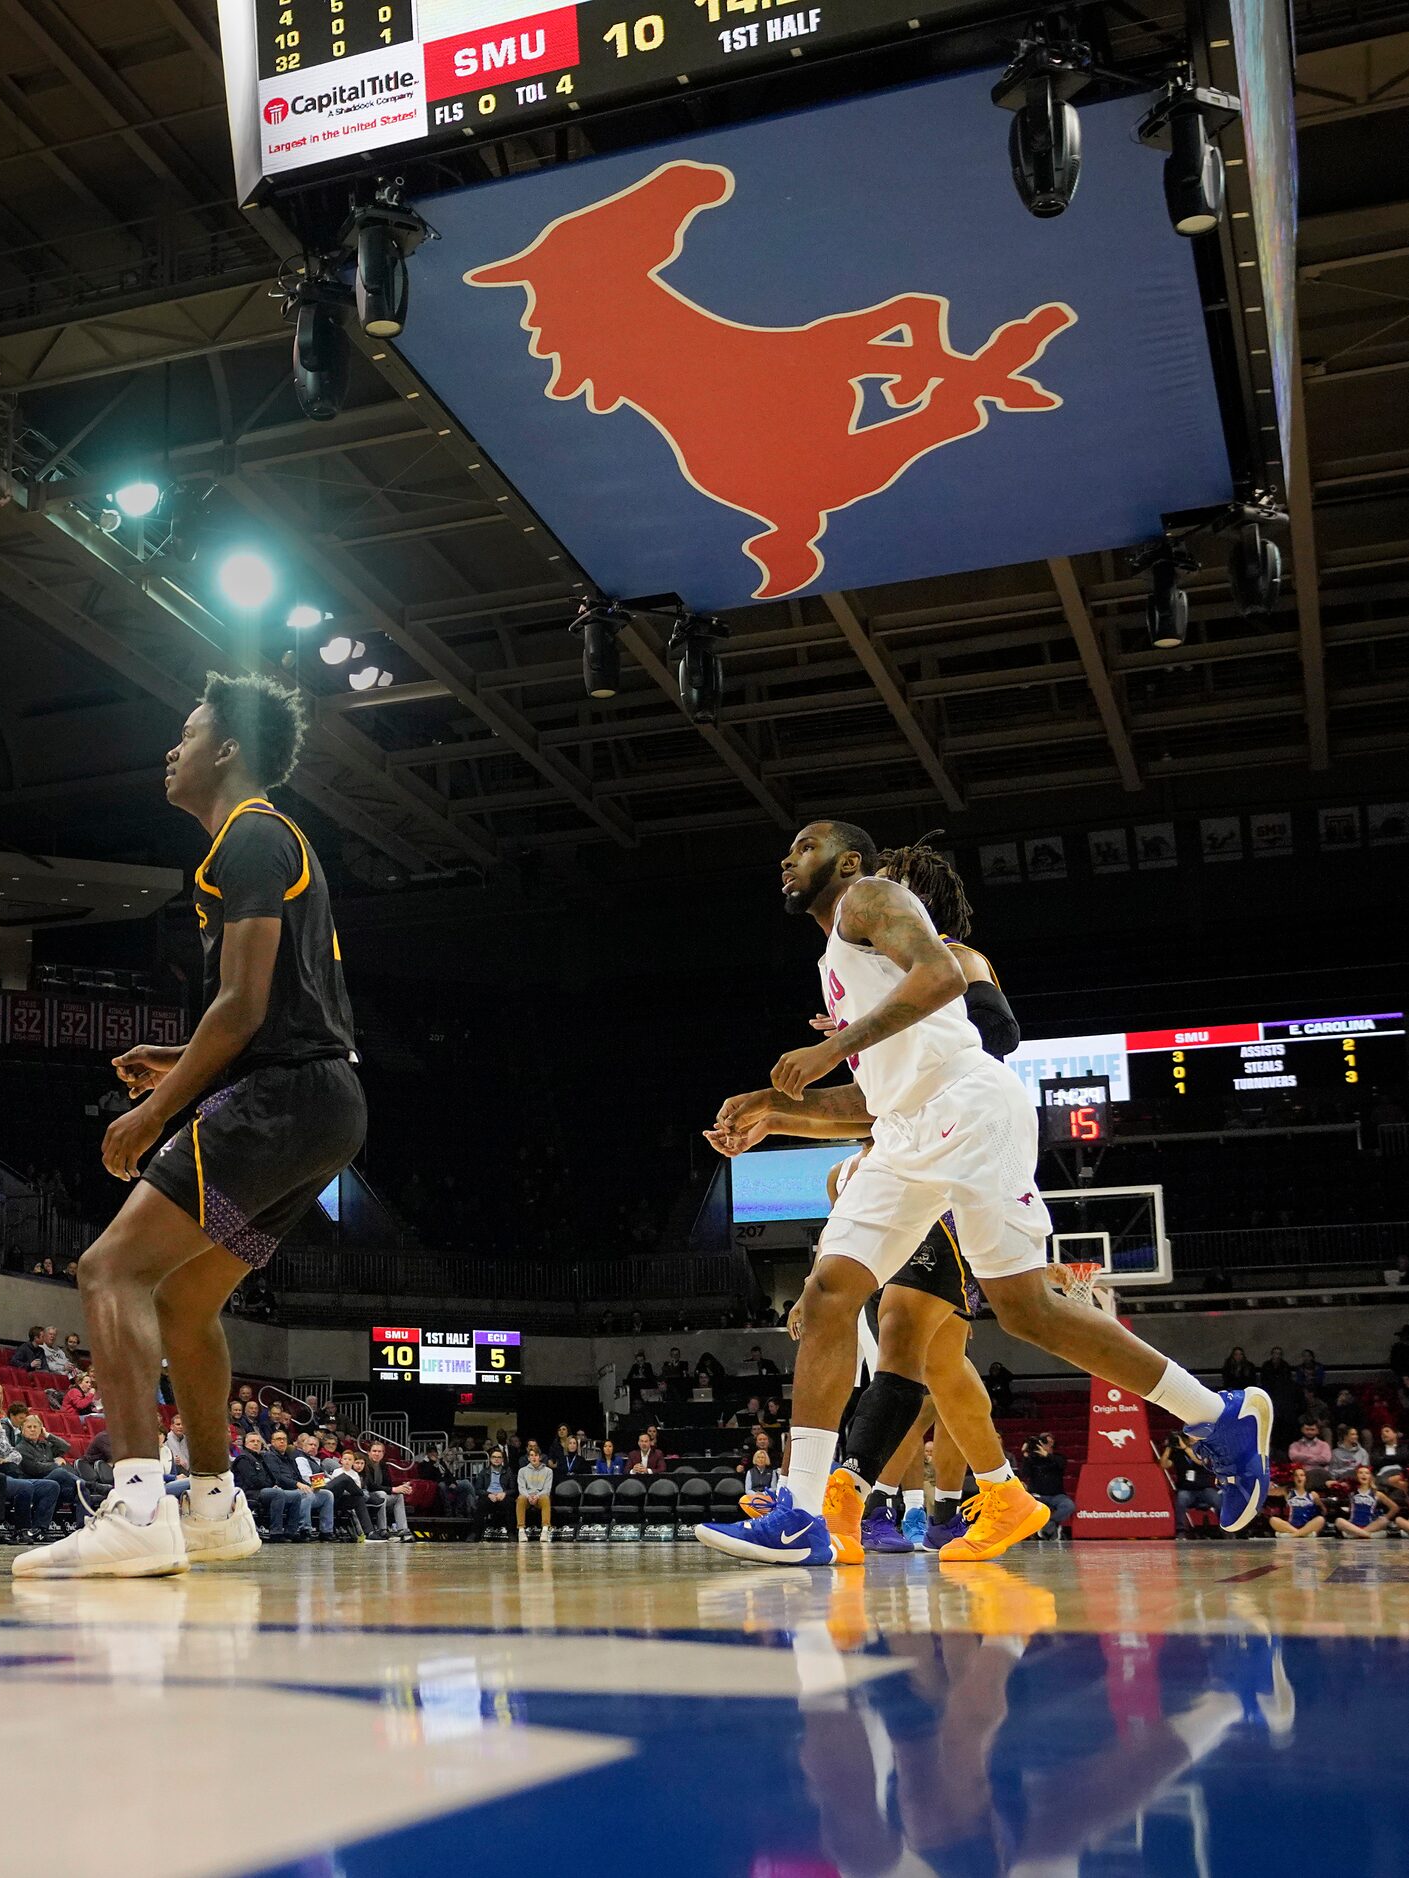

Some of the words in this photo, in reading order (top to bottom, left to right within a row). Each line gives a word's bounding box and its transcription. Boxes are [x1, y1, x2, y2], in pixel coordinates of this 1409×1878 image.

[274, 30, 300, 50] 10
[332, 18, 344, 35] 0
[378, 6, 392, 23] 0
[279, 9, 293, 26] 4
[602, 14, 664, 58] 10
[718, 23, 759, 53] 1ST
[766, 8, 821, 43] HALF
[276, 53, 300, 72] 32
[333, 40, 346, 57] 0
[380, 28, 392, 44] 1
[454, 29, 546, 78] SMU
[376, 91, 414, 107] Company
[435, 102, 464, 125] FLS
[478, 94, 496, 115] 0
[516, 82, 547, 105] TOL
[556, 74, 574, 95] 4
[268, 138, 307, 154] Largest
[310, 134, 320, 143] in
[322, 129, 340, 141] the
[342, 118, 376, 135] United
[380, 109, 417, 125] States!
[14, 1008, 42, 1034] 32
[60, 1011, 88, 1037] 32
[106, 1015, 133, 1041] 53
[152, 1018, 178, 1044] 50
[1289, 1024, 1303, 1036] E.
[1304, 1019, 1376, 1034] CAROLINA
[1175, 1032, 1209, 1044] SMU
[1172, 1051, 1184, 1062] 3
[1240, 1044, 1286, 1058] ASSISTS
[1342, 1038, 1356, 1050] 2
[1173, 1066, 1186, 1078] 0
[1244, 1060, 1284, 1074] STEALS
[1344, 1054, 1356, 1066] 1
[1174, 1082, 1186, 1094] 1
[1233, 1075, 1298, 1090] TURNOVERS
[1345, 1070, 1358, 1083] 3
[1070, 1108, 1100, 1139] 15
[736, 1224, 766, 1238] 207
[385, 1330, 408, 1340] SMU
[426, 1332, 444, 1344] 1ST
[446, 1333, 470, 1345] HALF
[488, 1334, 507, 1342] ECU
[381, 1346, 414, 1366] 10
[445, 1360, 472, 1373] TIME
[490, 1348, 506, 1368] 5
[404, 1372, 412, 1382] 0
[504, 1375, 512, 1384] 2
[1093, 1404, 1117, 1414] Origin
[1119, 1403, 1138, 1413] Bank
[1077, 1509, 1170, 1520] dfwbmwdealers.com
